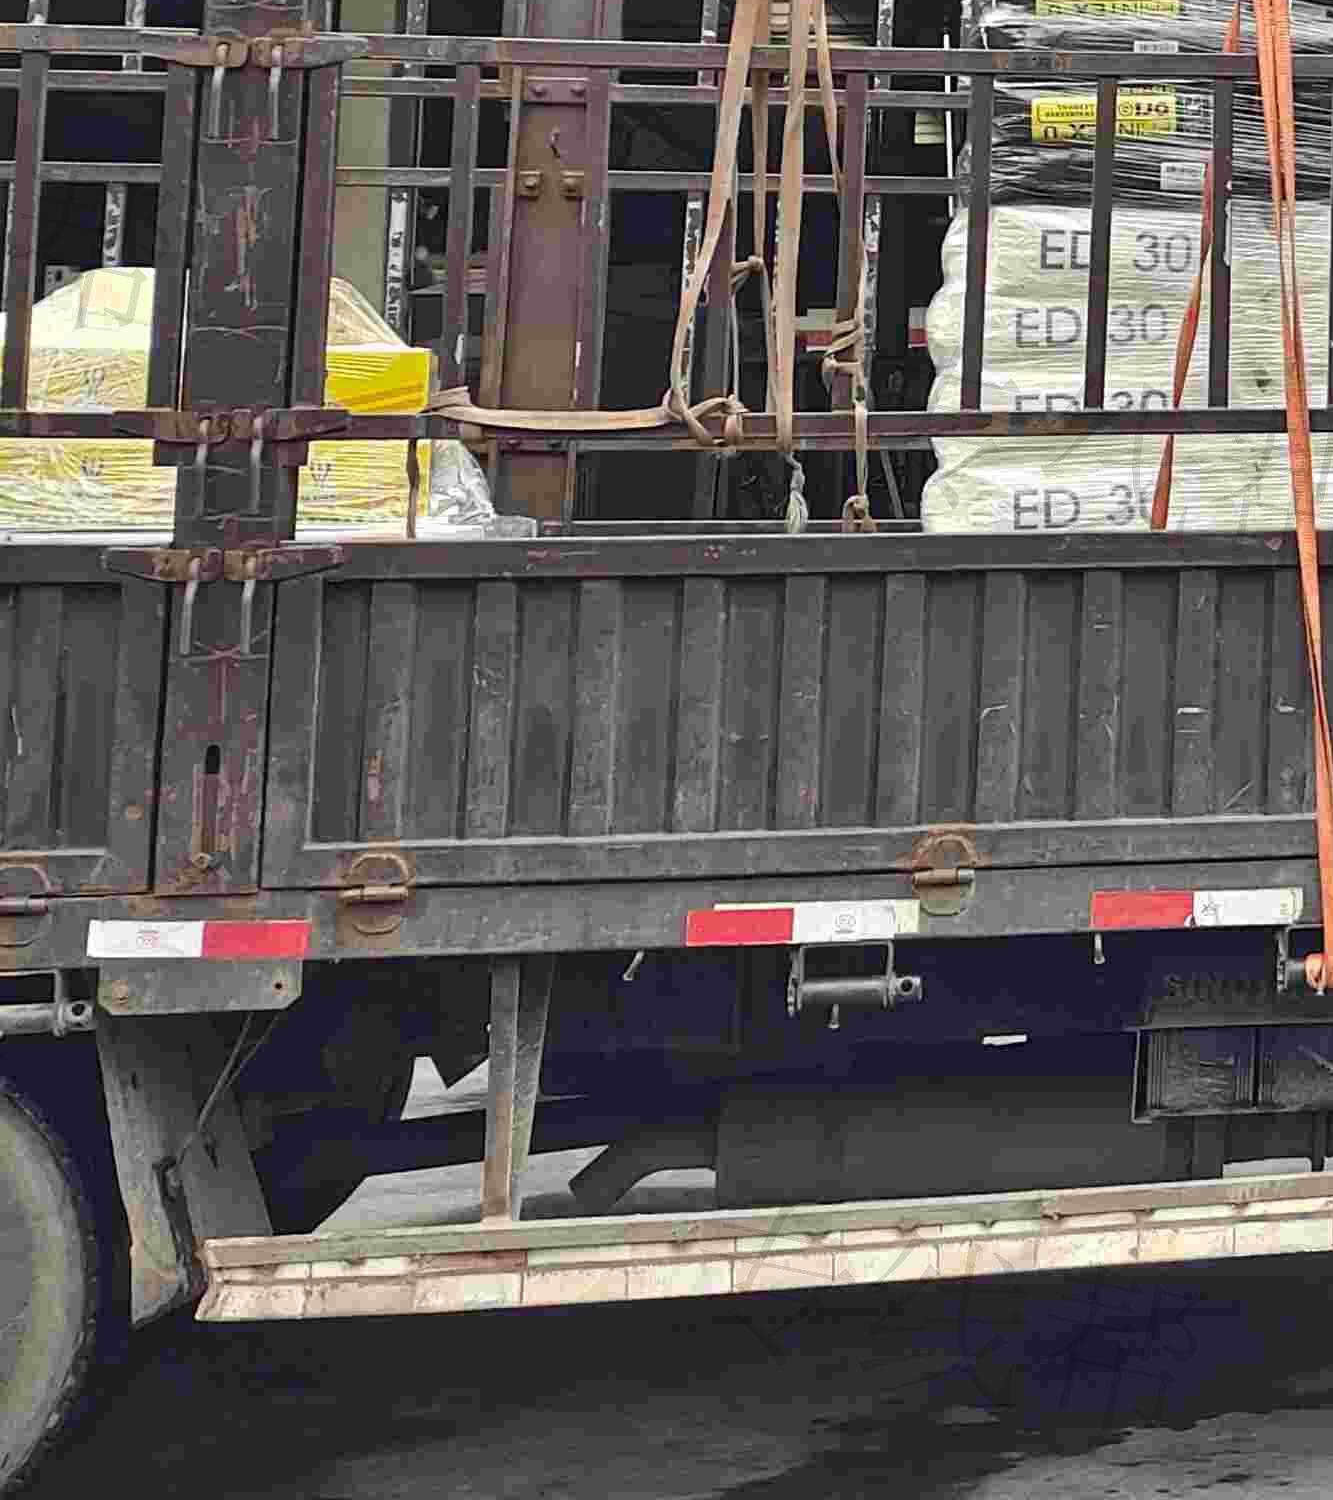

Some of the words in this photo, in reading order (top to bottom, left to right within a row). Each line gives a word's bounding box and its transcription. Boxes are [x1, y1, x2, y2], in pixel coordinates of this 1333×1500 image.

[1133, 233, 1194, 273] 30
[1015, 305, 1082, 349] ED
[1107, 303, 1168, 345] 30
[1014, 488, 1081, 531] ED
